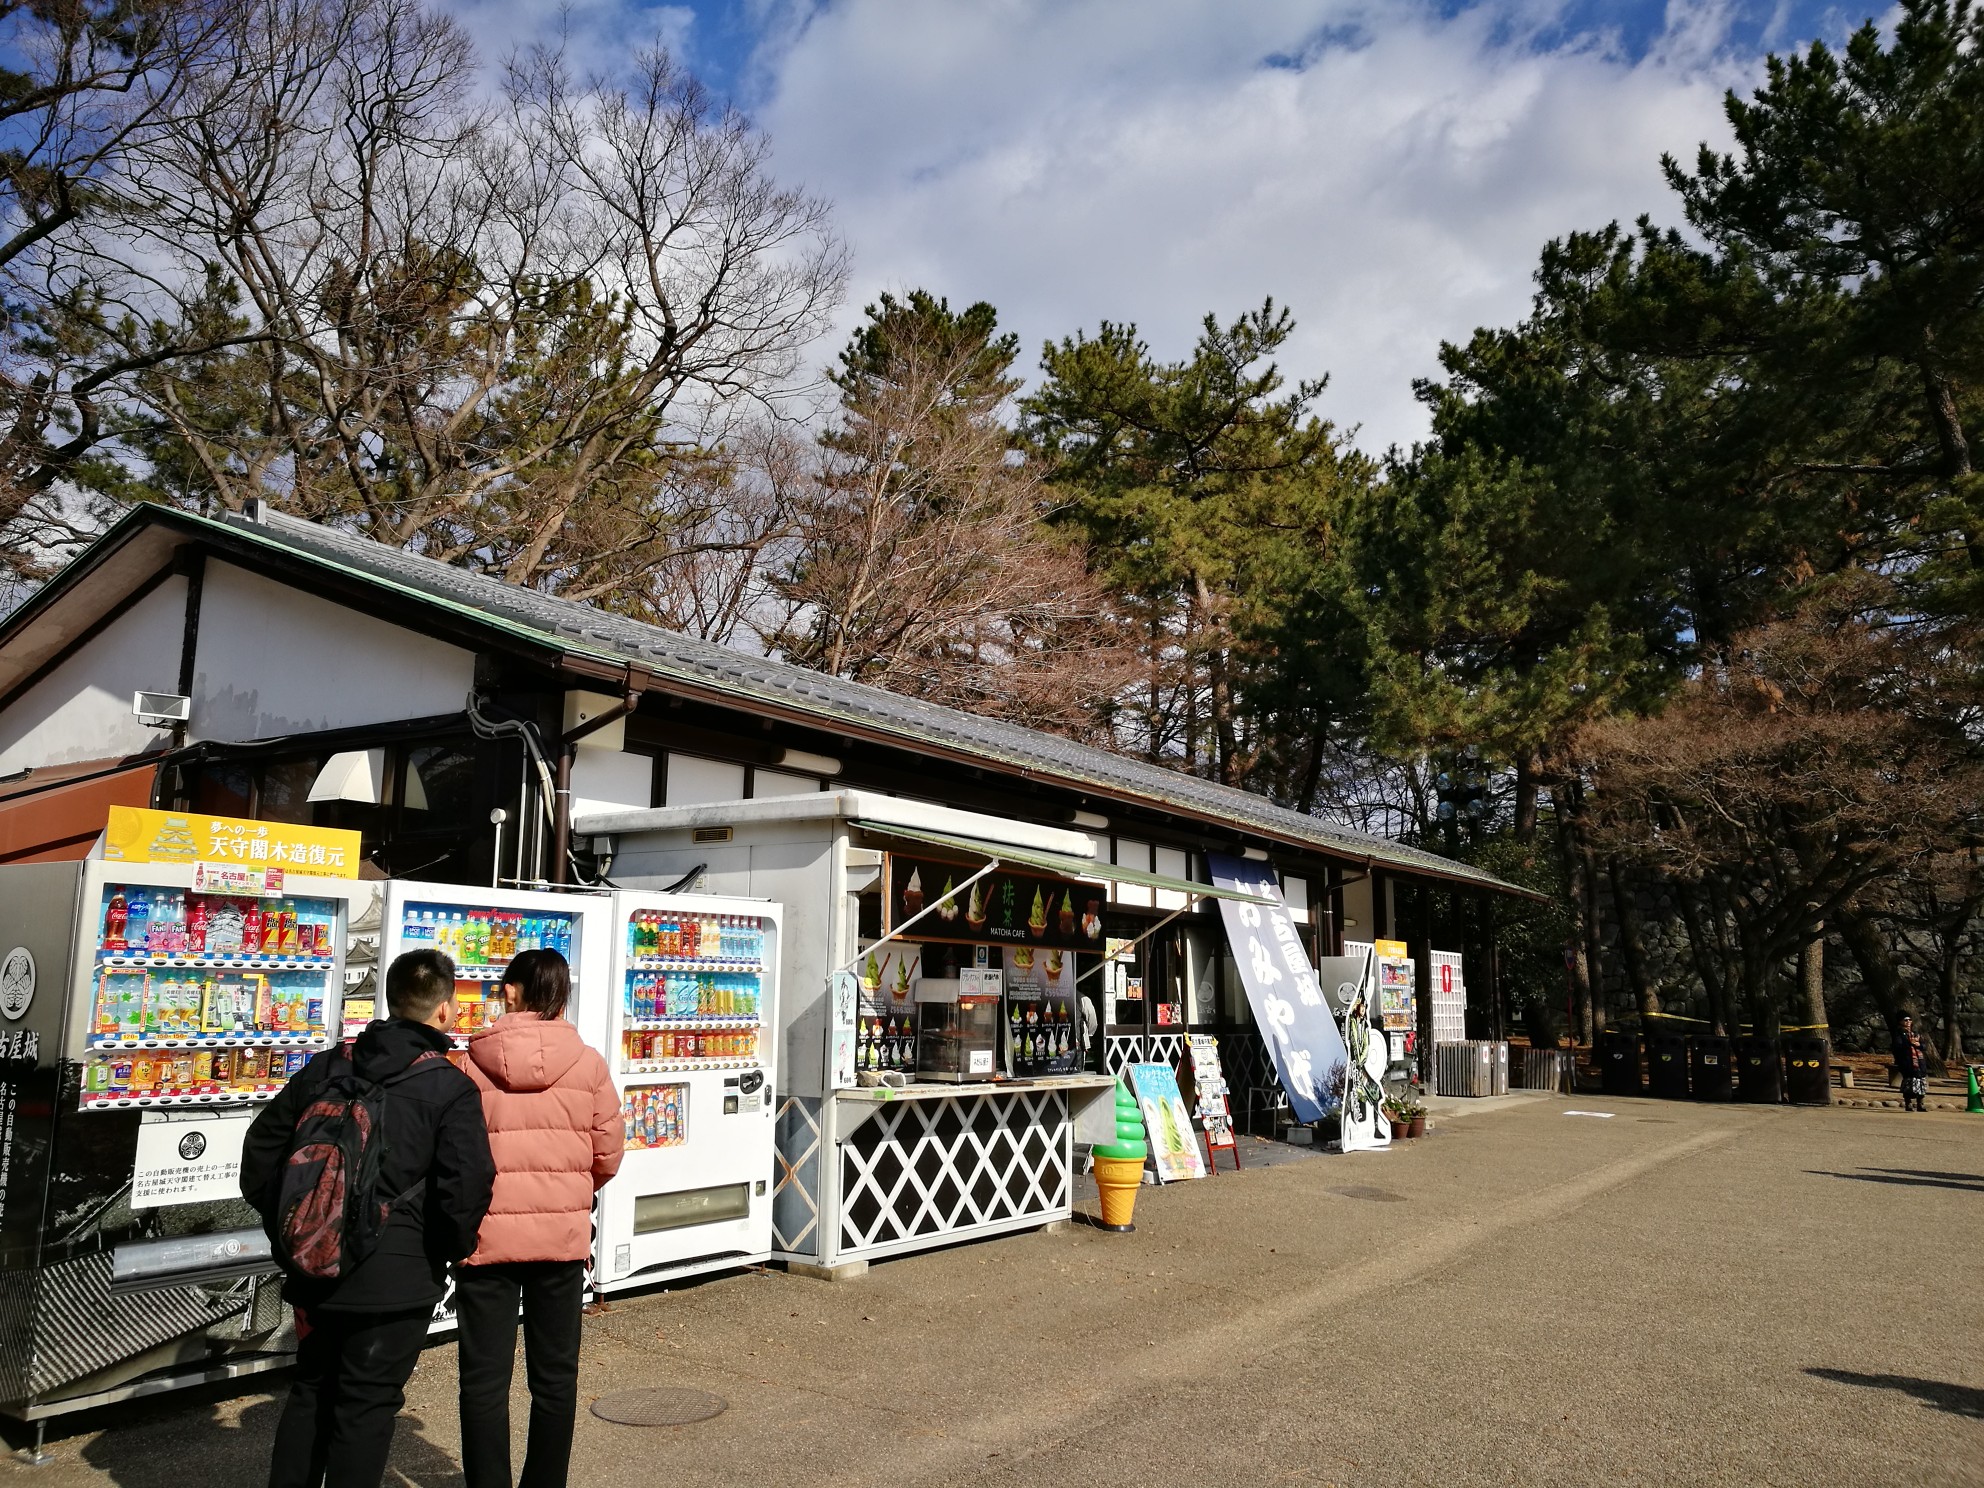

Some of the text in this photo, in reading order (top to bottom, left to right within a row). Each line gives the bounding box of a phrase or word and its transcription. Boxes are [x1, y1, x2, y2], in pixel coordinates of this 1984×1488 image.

[210, 821, 268, 838] 夢への一歩
[208, 836, 345, 867] 天守閣木造復元
[220, 871, 246, 882] 名古屋
[990, 927, 1026, 938] MATCHA CAFE
[0, 1030, 40, 1061] 古屋城
[138, 1162, 239, 1178] この自動販売機の売上の一部は
[136, 1171, 238, 1188] 名古屋城天守閣建て替え工事の
[135, 1184, 198, 1198] 支援に使われます。
